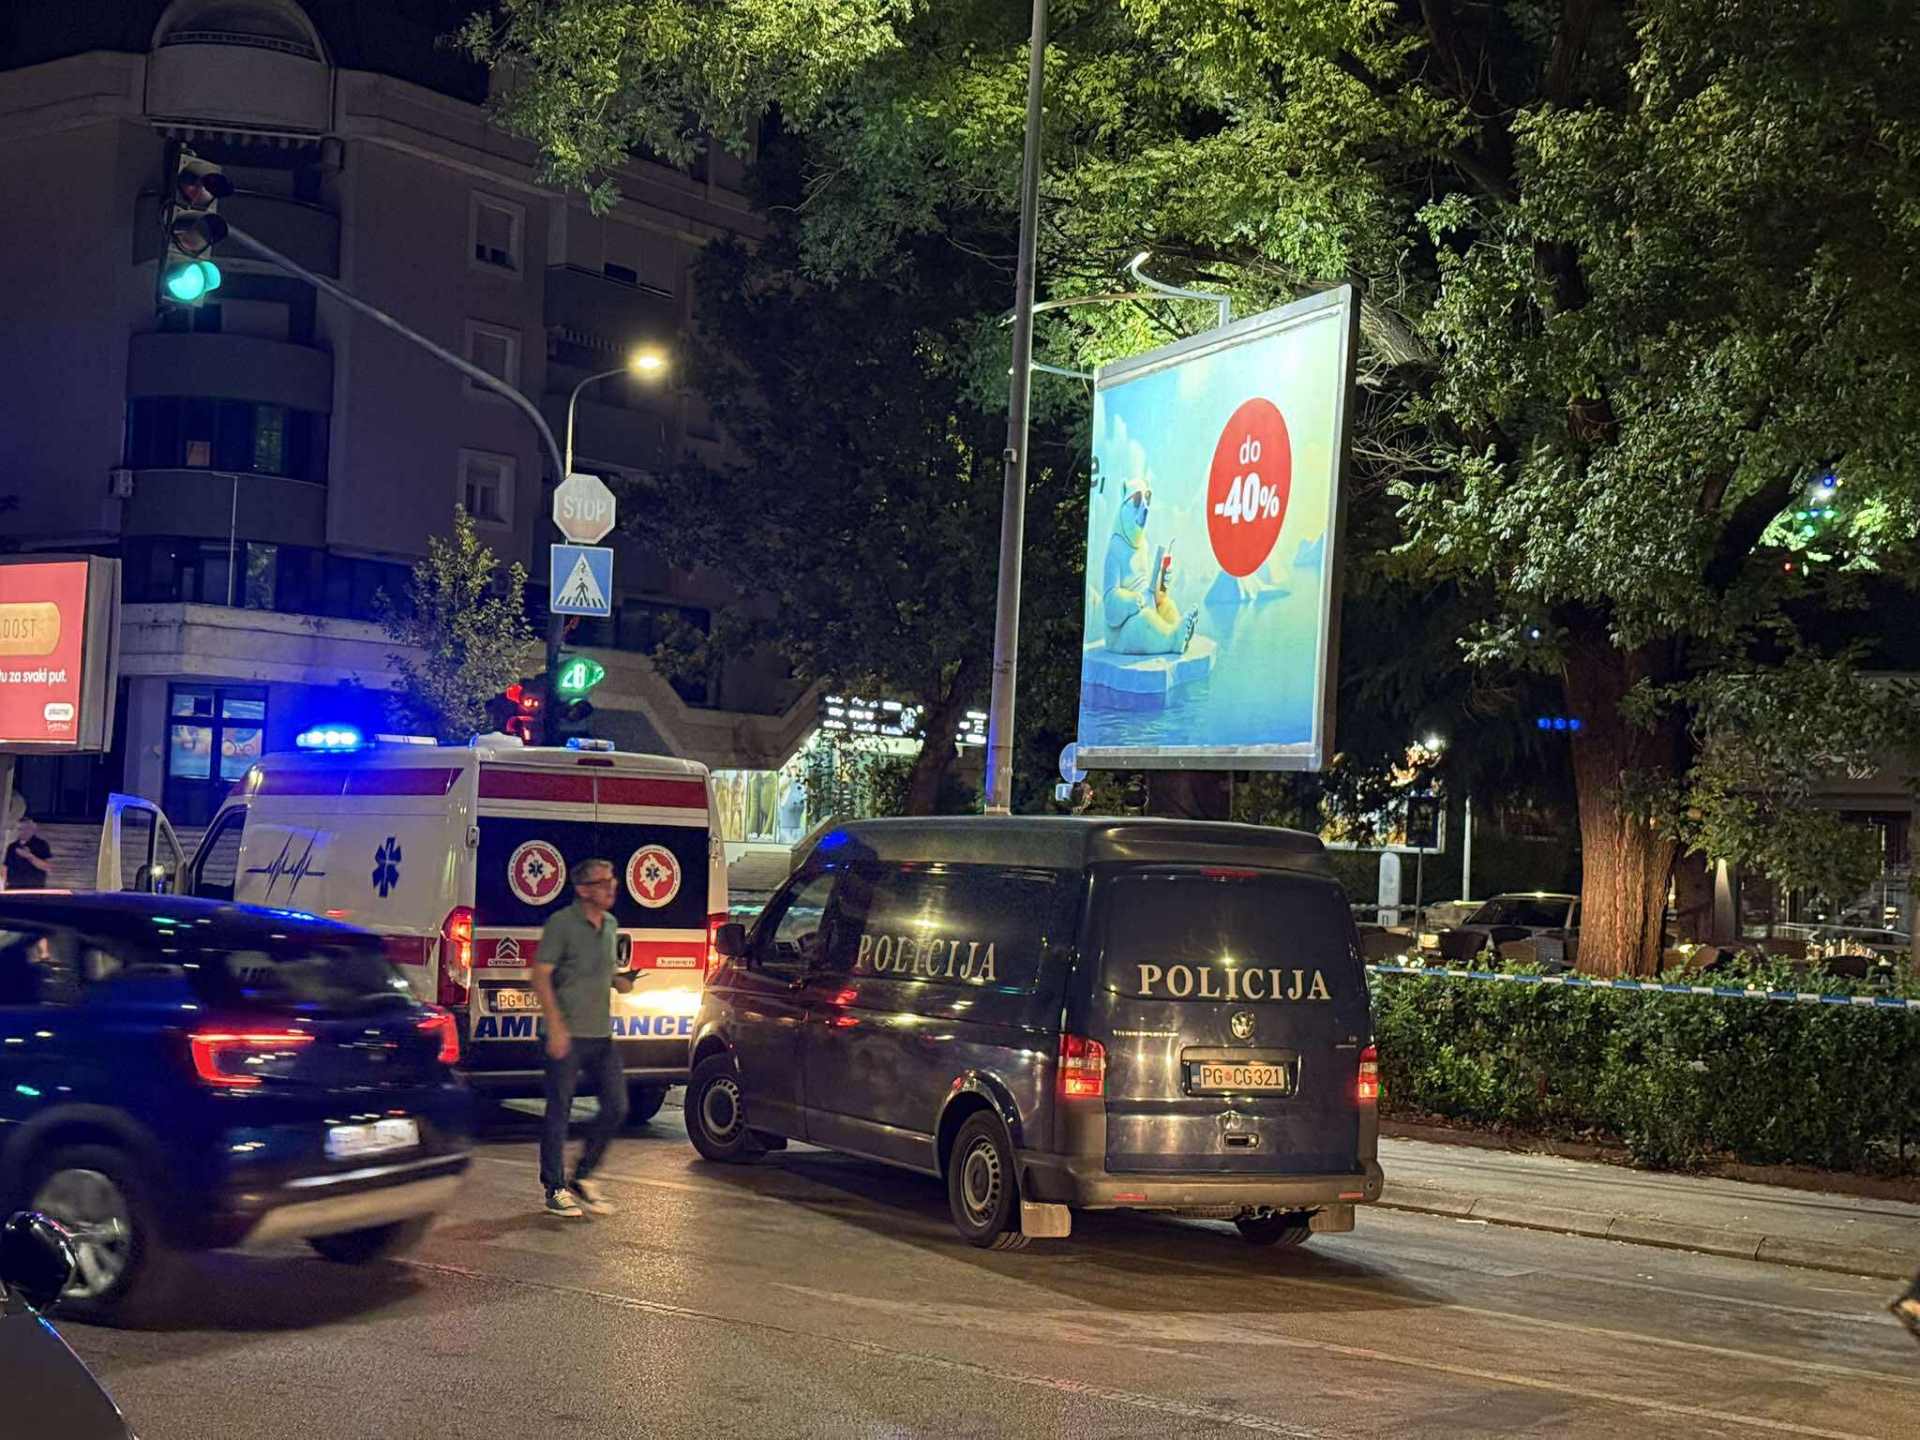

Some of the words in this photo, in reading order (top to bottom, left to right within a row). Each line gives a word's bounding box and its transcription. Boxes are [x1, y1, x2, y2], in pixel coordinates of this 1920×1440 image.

[1239, 433, 1261, 464] do
[563, 496, 607, 521] STOP
[1214, 472, 1280, 525] -40%
[8, 671, 21, 683] za
[23, 667, 47, 683] svaki
[48, 668, 68, 688] put.
[855, 934, 996, 981] POLICIJA
[1137, 964, 1332, 1000] POLICIJA
[499, 994, 516, 1008] PG
[474, 1015, 694, 1037] AMANCE
[1202, 1067, 1223, 1086] PG
[1233, 1067, 1282, 1087] CG321
